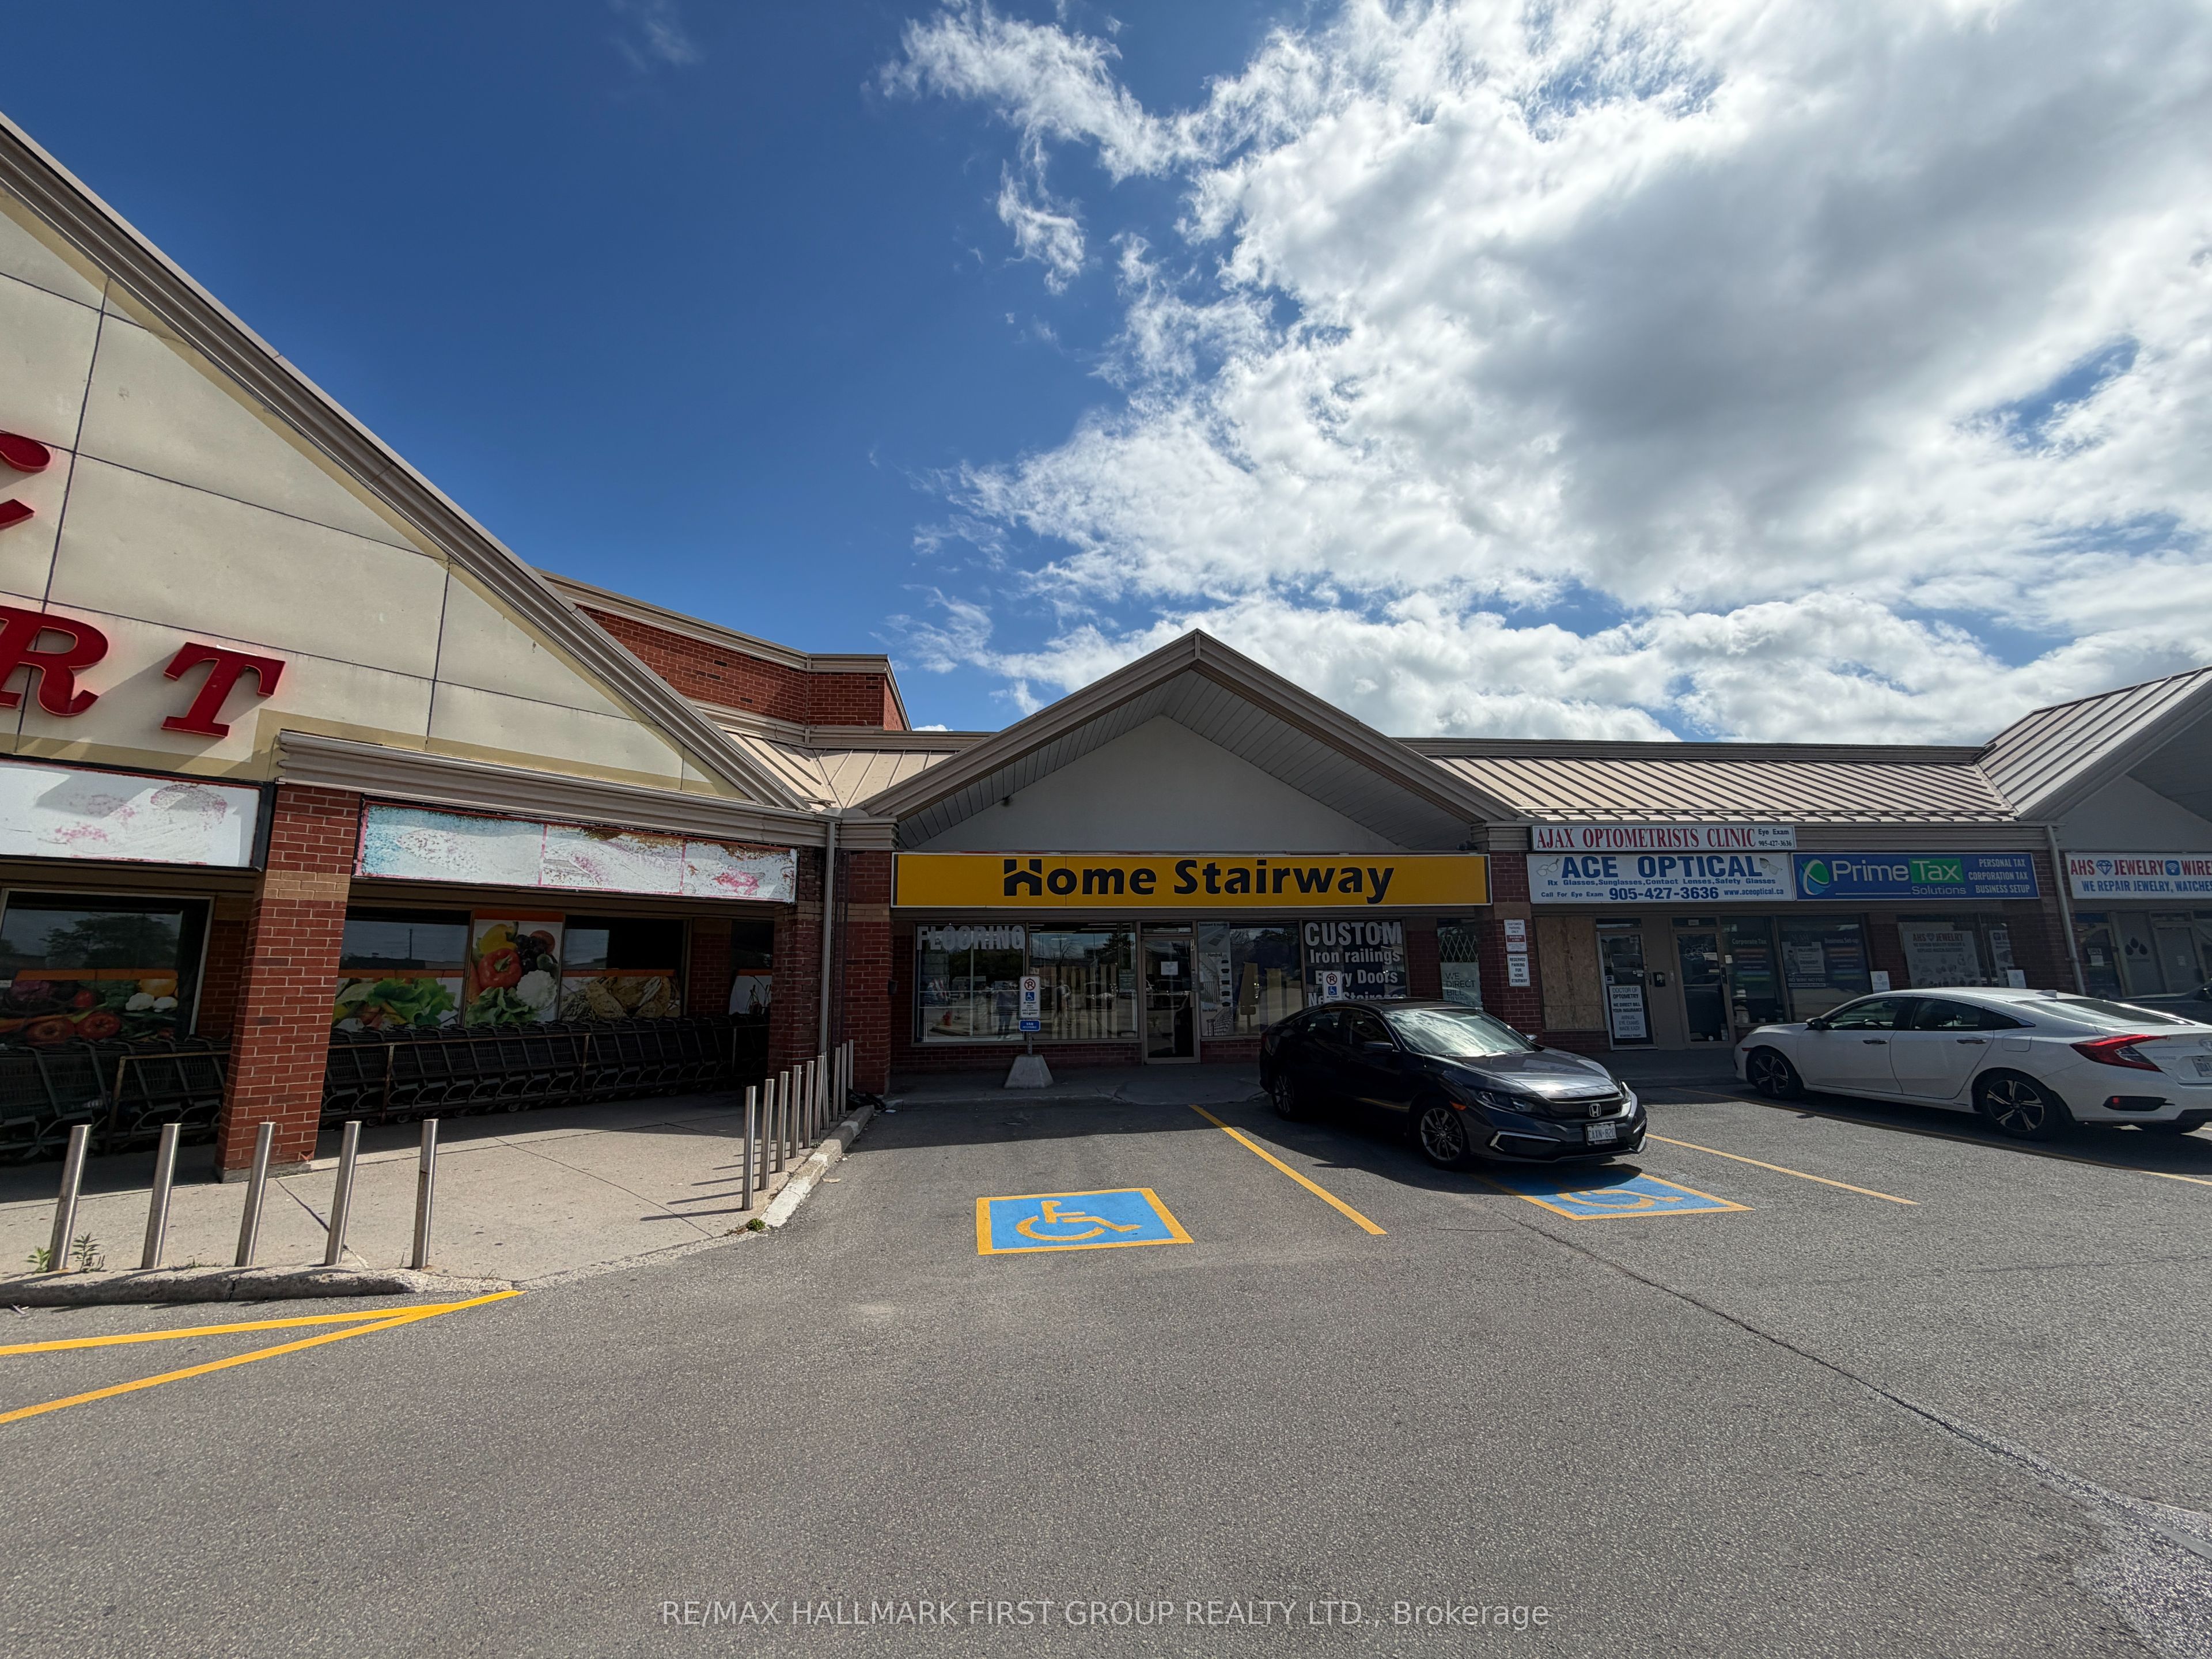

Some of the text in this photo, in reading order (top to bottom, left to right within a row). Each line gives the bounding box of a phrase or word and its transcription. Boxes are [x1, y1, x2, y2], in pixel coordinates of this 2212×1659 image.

[1537, 828, 1756, 848] AJAX OPTOMETRISTS CLINIC
[1562, 855, 1763, 878] ACE OPTICAL
[1979, 858, 2026, 868] PERSONAL TAX
[2070, 859, 2212, 876] AHS JEWELRY WIRE
[1831, 859, 1960, 882] Prime Tax
[1968, 872, 2028, 881] CORPORATION TAX
[1003, 859, 1395, 903] Home Stairway
[2081, 881, 2095, 892] WE
[2098, 881, 2131, 892] REPAIR
[2133, 881, 2173, 893] JEWELRY,
[1609, 887, 1719, 900] 905-427-3636
[1724, 888, 1784, 896] www.aceoptical.ca
[1911, 886, 1967, 895] Solutions
[1975, 884, 2030, 893] BUSINESS SETUP
[916, 925, 1025, 950] FLOORING
[1305, 922, 1403, 946] CUSTOM
[1912, 933, 1963, 941] AHS JEWELRY
[1310, 948, 1401, 965] Iron railings
[1357, 969, 1398, 984] Doors
[1446, 980, 1476, 988] DIRECT
[1308, 993, 1324, 1007] Ne
